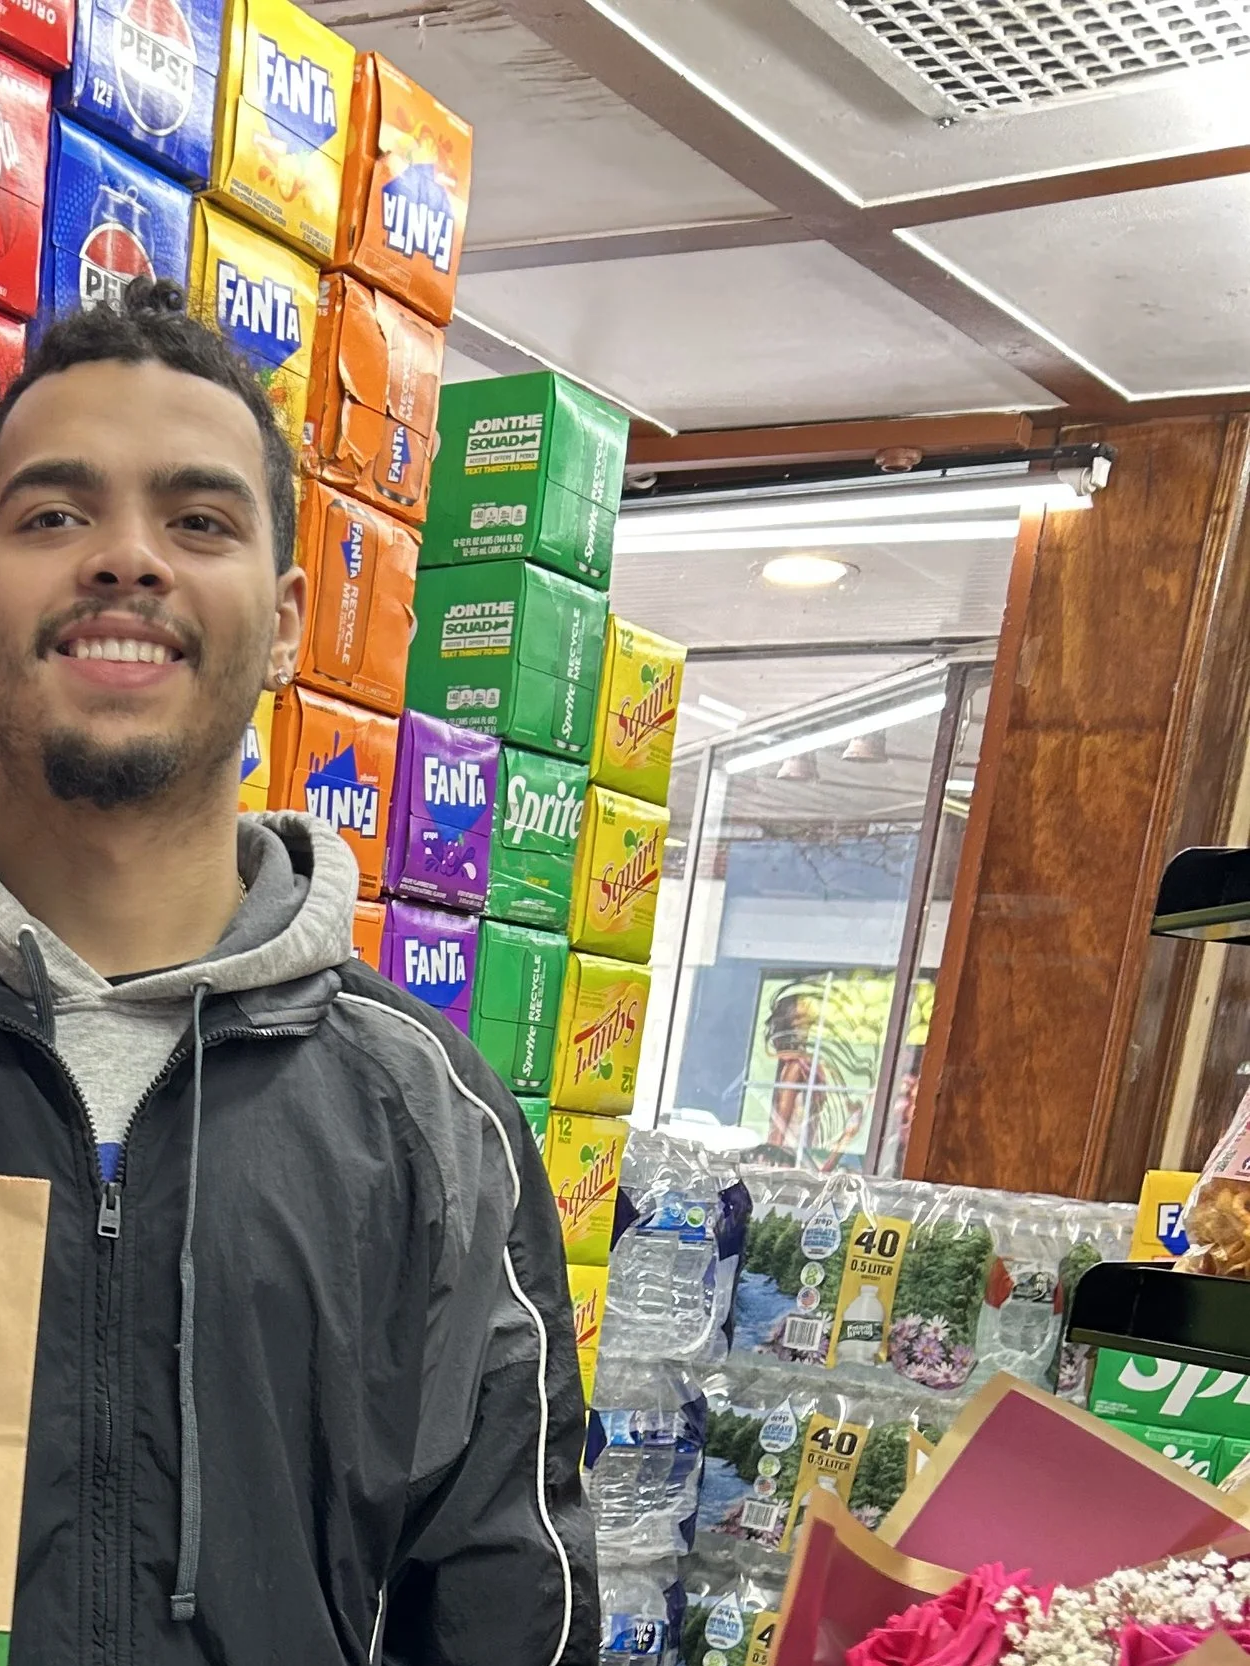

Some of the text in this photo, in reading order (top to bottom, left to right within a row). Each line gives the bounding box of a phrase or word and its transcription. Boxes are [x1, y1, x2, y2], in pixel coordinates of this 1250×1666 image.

[120, 22, 191, 92] PEPSI
[257, 33, 336, 127] FANTA
[383, 193, 453, 273] FANTA
[217, 259, 300, 341] FANTA
[469, 414, 543, 434] JOIN THE
[470, 434, 519, 450] SQUAD
[387, 426, 405, 483] FANTA
[350, 520, 365, 580] FANTA
[341, 584, 360, 666] RECYCLE
[445, 601, 515, 618] JOIN THE
[445, 621, 492, 635] SQUAD
[567, 607, 581, 679] RECYCLE
[561, 684, 576, 740] Sprite
[616, 665, 676, 752] Squirt
[425, 756, 487, 807] FANTA
[599, 826, 660, 918] Squirt
[405, 940, 467, 986] FANTA
[528, 955, 542, 1021] RECYCLE
[522, 1026, 537, 1077] Sprite
[574, 998, 638, 1086] Squirt
[557, 1116, 572, 1137] 12
[558, 1139, 618, 1228] Squirt
[850, 1259, 893, 1276] 0.5 LITER
[854, 1227, 900, 1258] 40
[811, 1426, 858, 1456] 40
[825, 1458, 852, 1473] LITER
